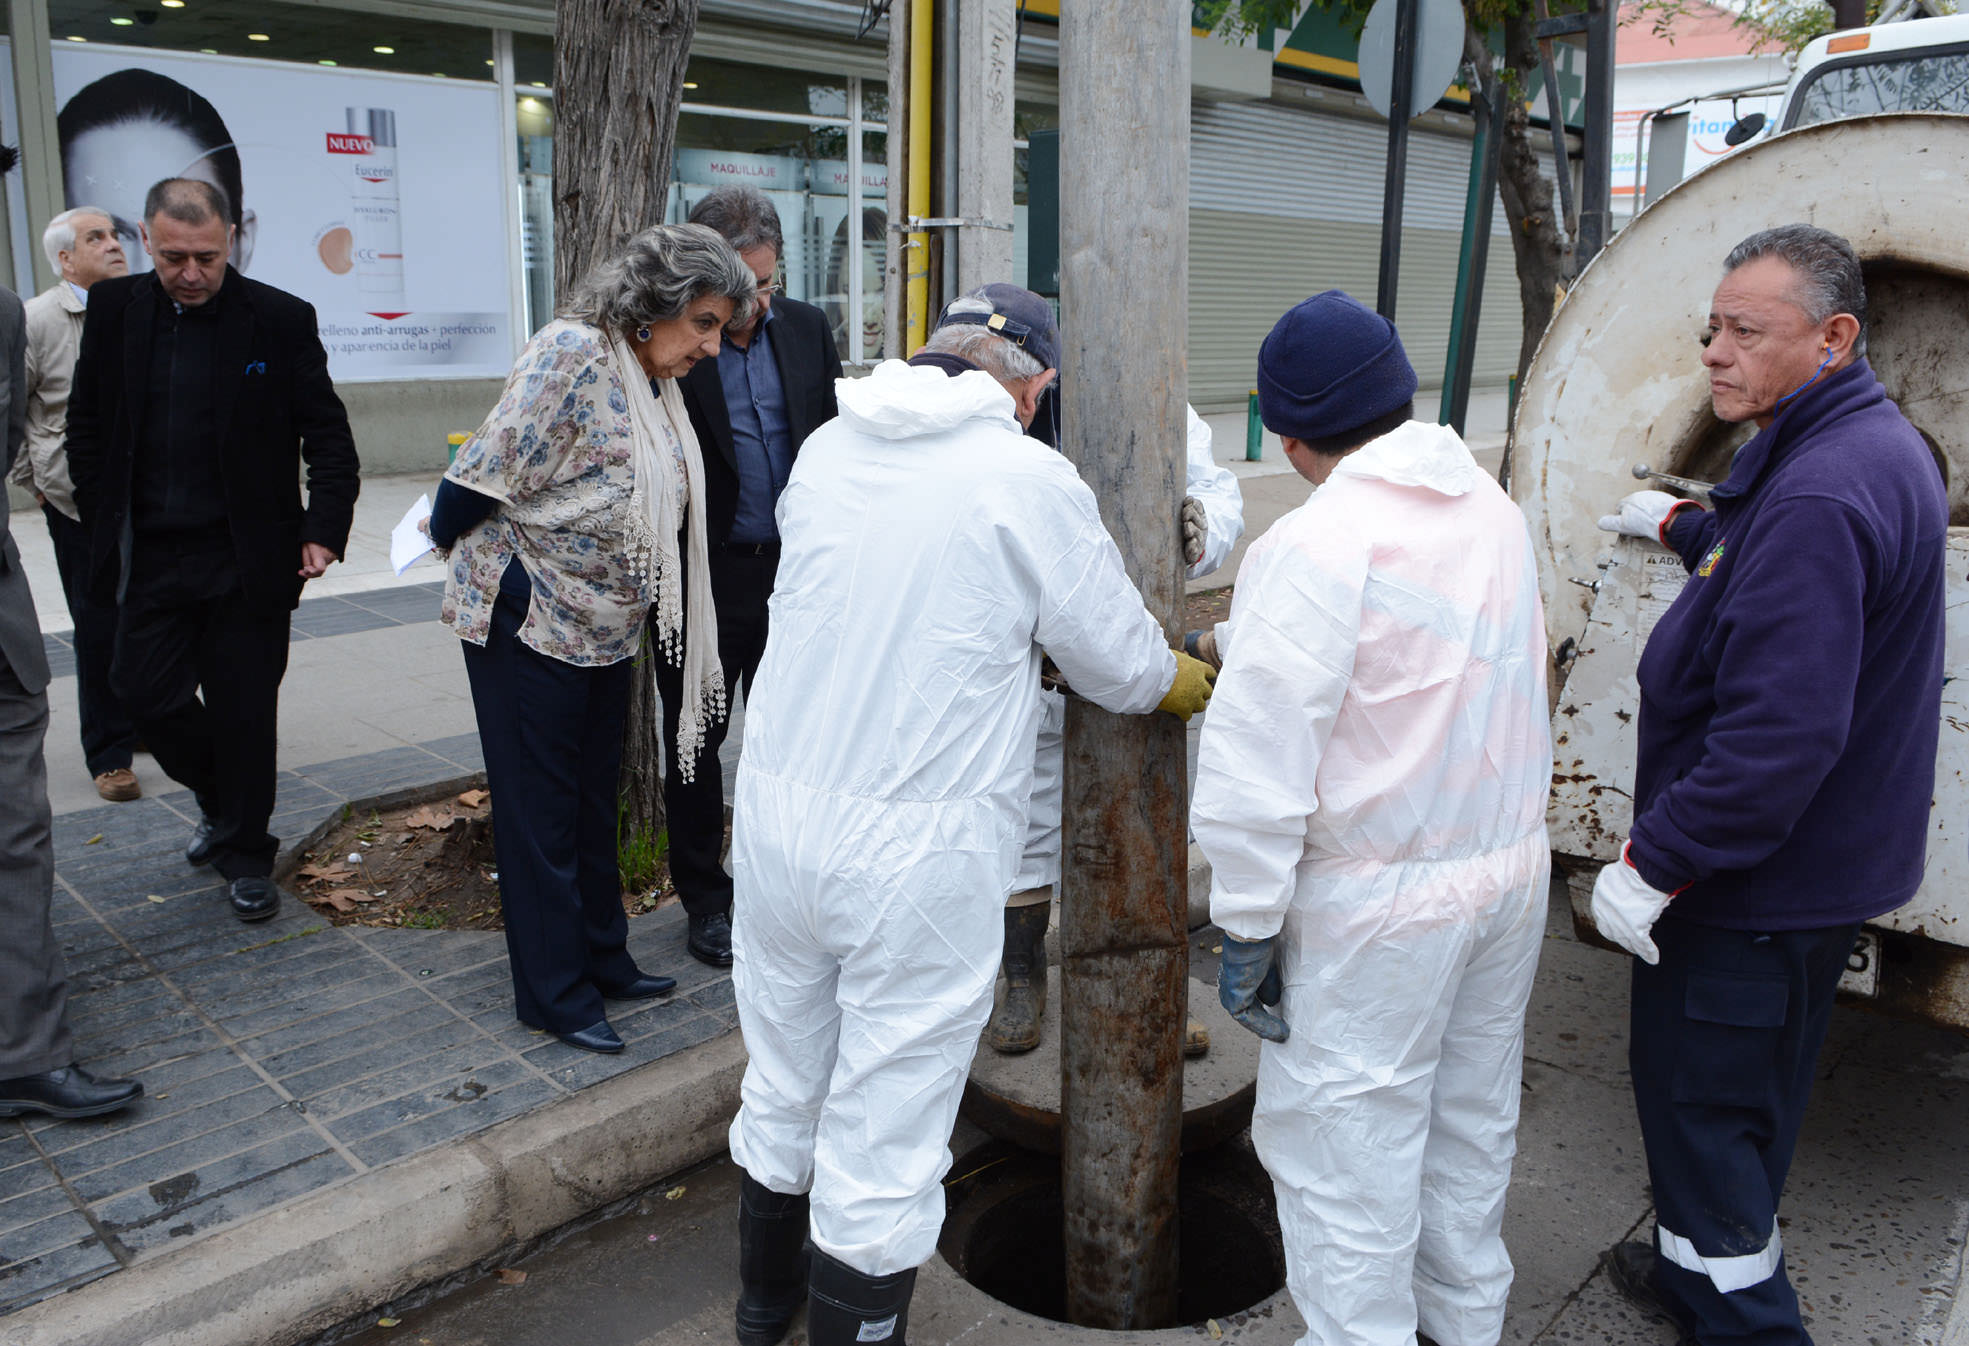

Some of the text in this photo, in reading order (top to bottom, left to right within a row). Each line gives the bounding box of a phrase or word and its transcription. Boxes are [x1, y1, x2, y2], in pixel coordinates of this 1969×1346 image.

[329, 136, 375, 152] NUEVO
[355, 163, 394, 177] Eucerin
[710, 162, 777, 177] MAQUILLAJE
[360, 323, 430, 338] anti-arrugas
[401, 339, 416, 352] de
[418, 339, 430, 352] la
[431, 338, 453, 355] piel
